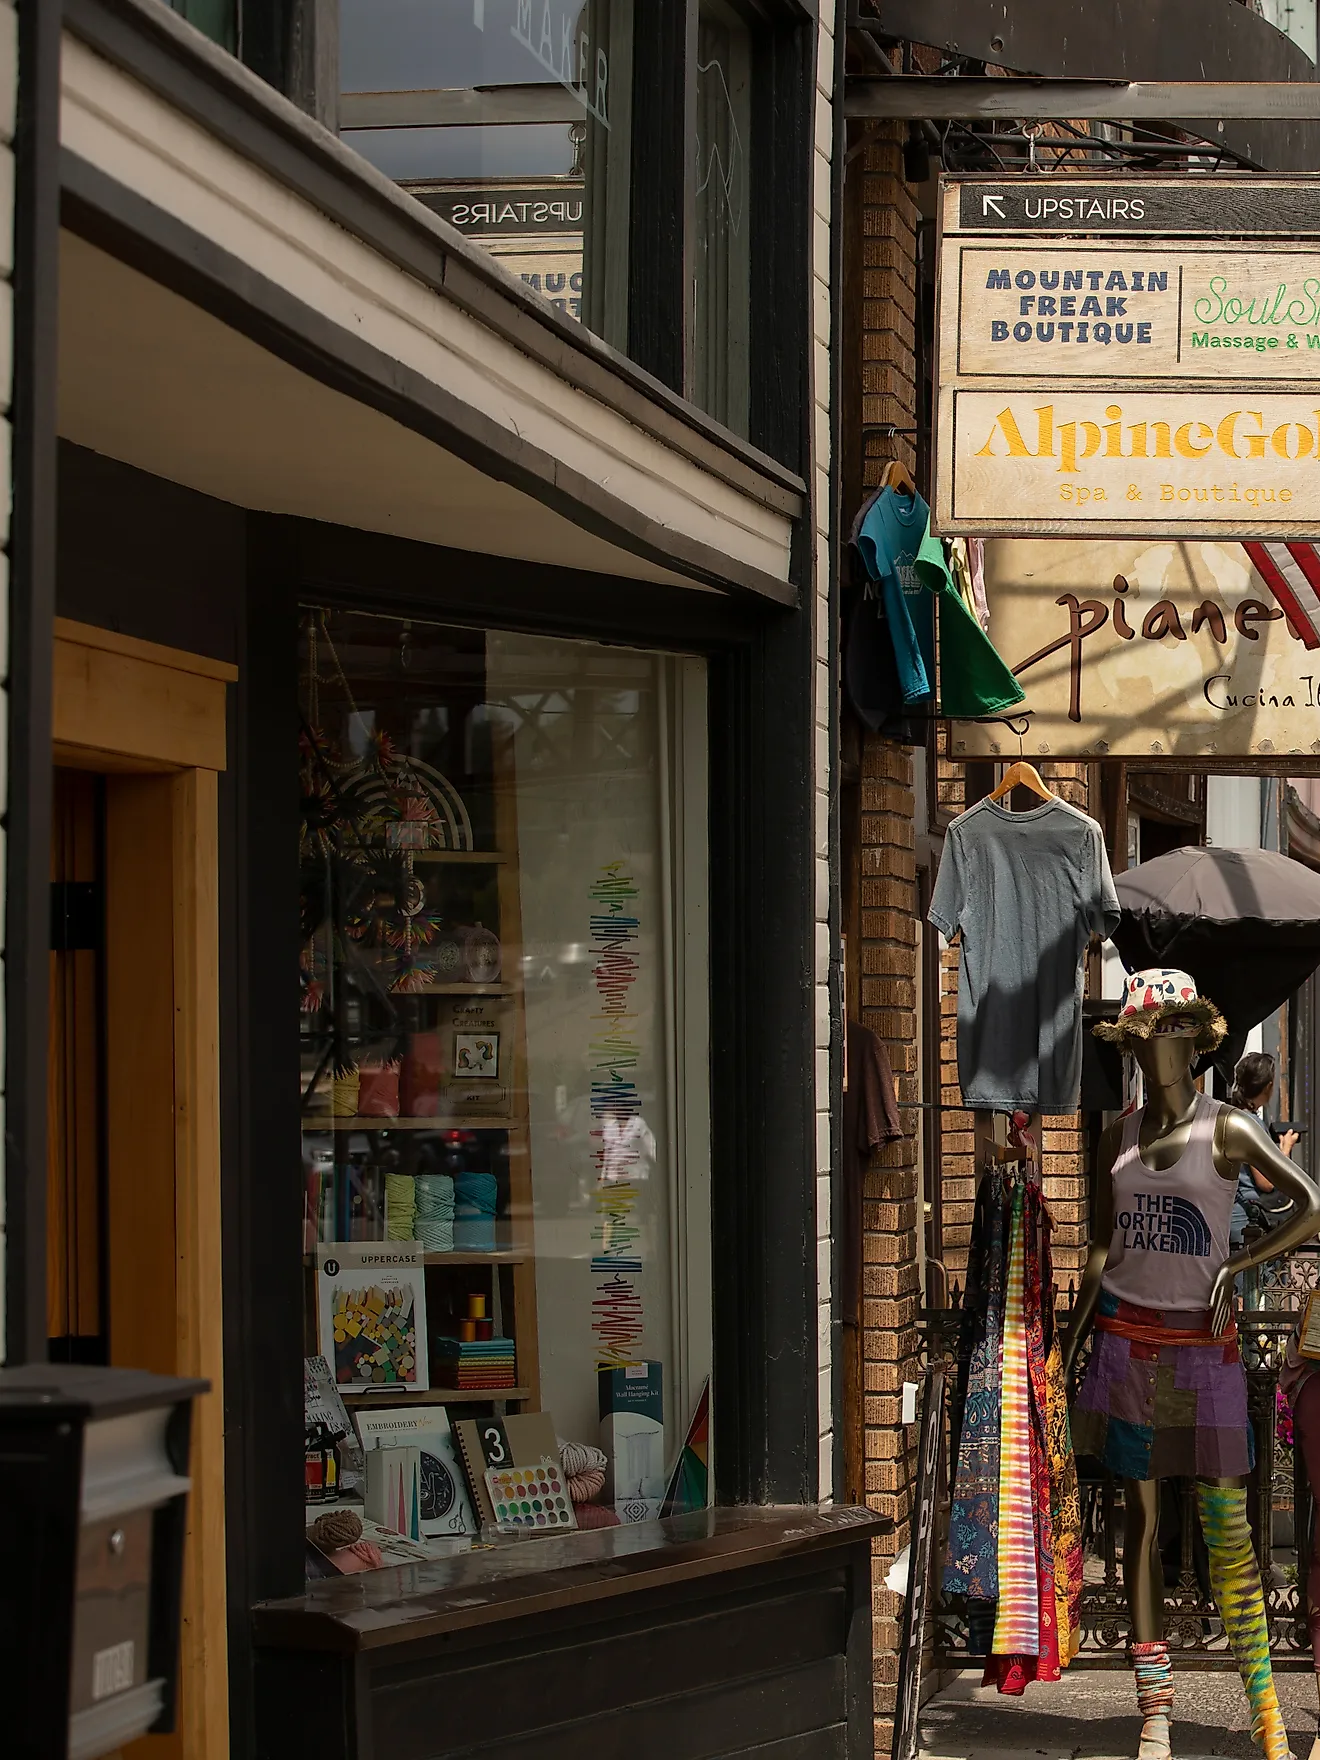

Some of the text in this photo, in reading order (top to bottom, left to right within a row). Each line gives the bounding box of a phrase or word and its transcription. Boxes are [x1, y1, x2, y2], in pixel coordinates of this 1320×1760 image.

[1024, 199, 1145, 220] UPSTAIRS
[986, 269, 1169, 292] MOUNTAIN
[1019, 295, 1129, 317] FREAK
[991, 321, 1153, 345] BOUTIQUE
[1191, 333, 1278, 352] Massage
[1287, 333, 1300, 348] &
[1060, 484, 1294, 507] Spa & Boutique
[1010, 574, 1300, 722] piane
[1203, 675, 1295, 710] Cucina
[1133, 1193, 1173, 1214] THE
[1114, 1212, 1171, 1233] ORTH
[1123, 1231, 1174, 1253] LAKE
[361, 1255, 417, 1263] UPPERCASE
[366, 1420, 418, 1431] EMBROIDERY
[484, 1427, 506, 1462] 3
